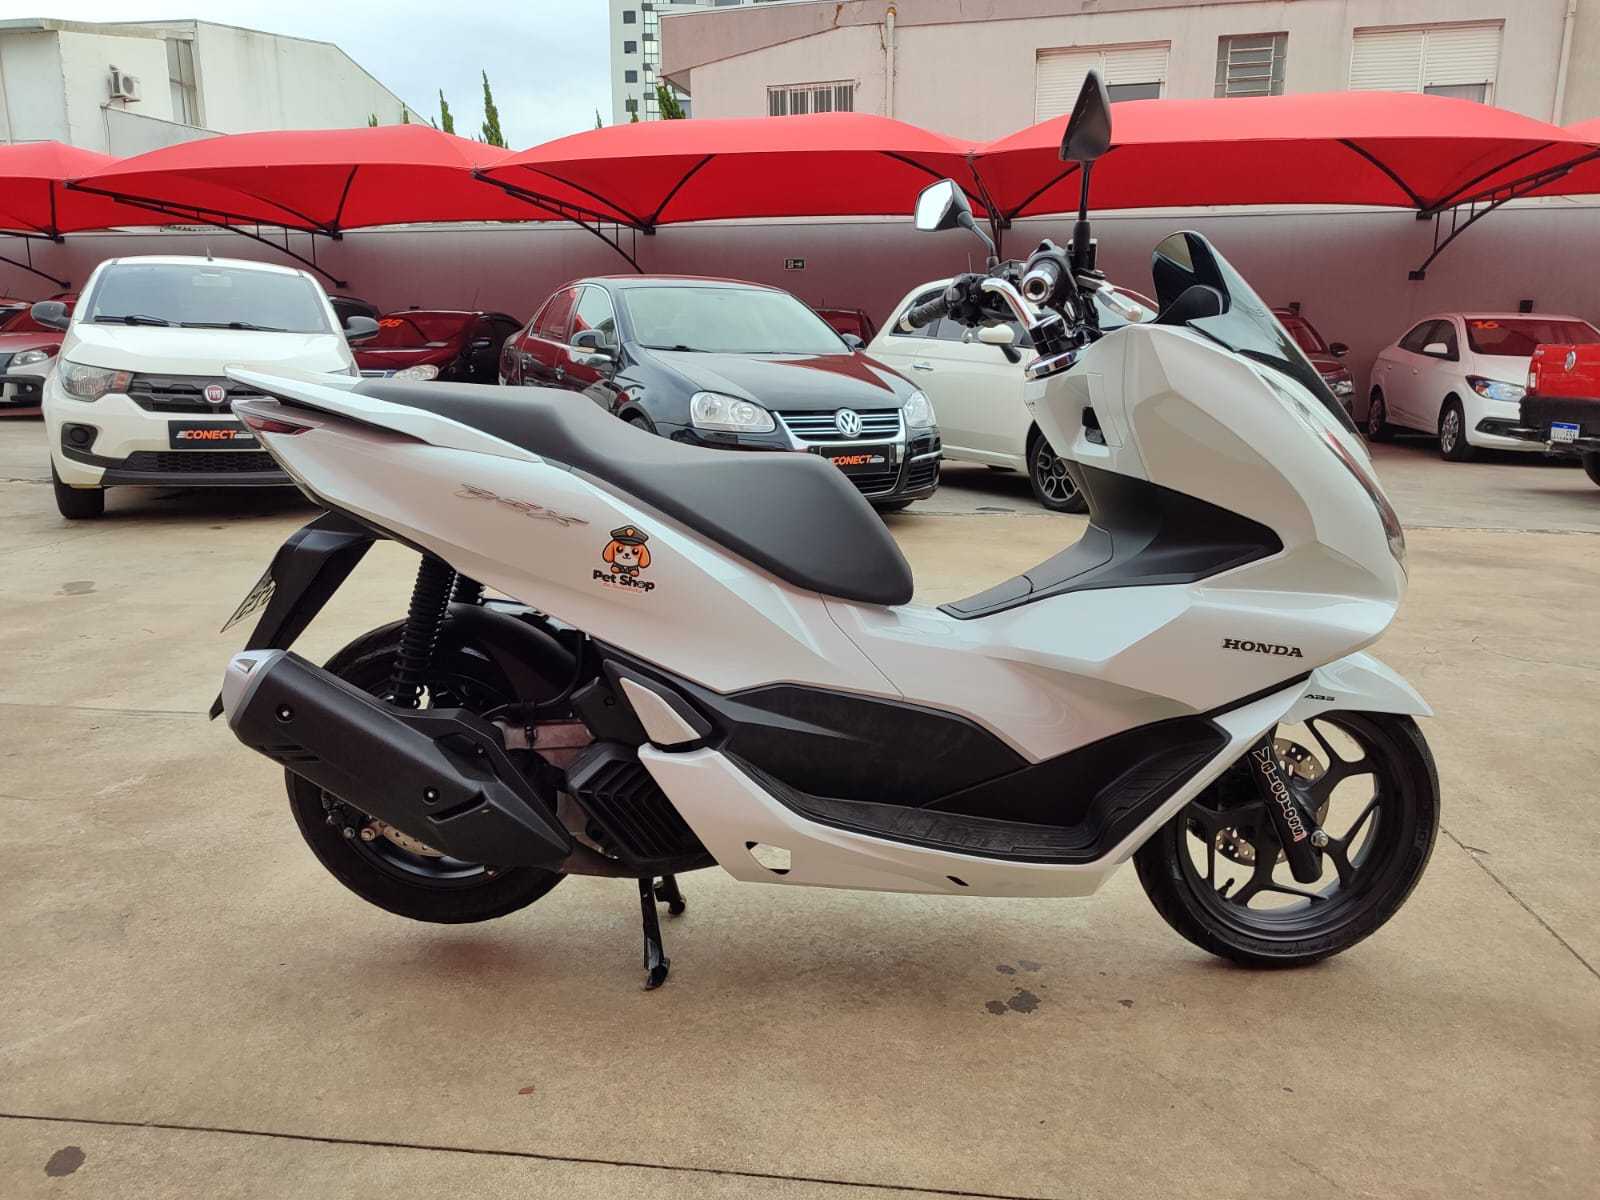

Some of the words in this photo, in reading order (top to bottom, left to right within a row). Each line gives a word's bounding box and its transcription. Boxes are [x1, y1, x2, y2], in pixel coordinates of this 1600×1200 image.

[184, 430, 237, 440] CONECT
[832, 455, 872, 465] CONECT
[592, 570, 616, 585] Pet
[619, 575, 655, 593] Shop
[1223, 638, 1303, 658] HONDA
